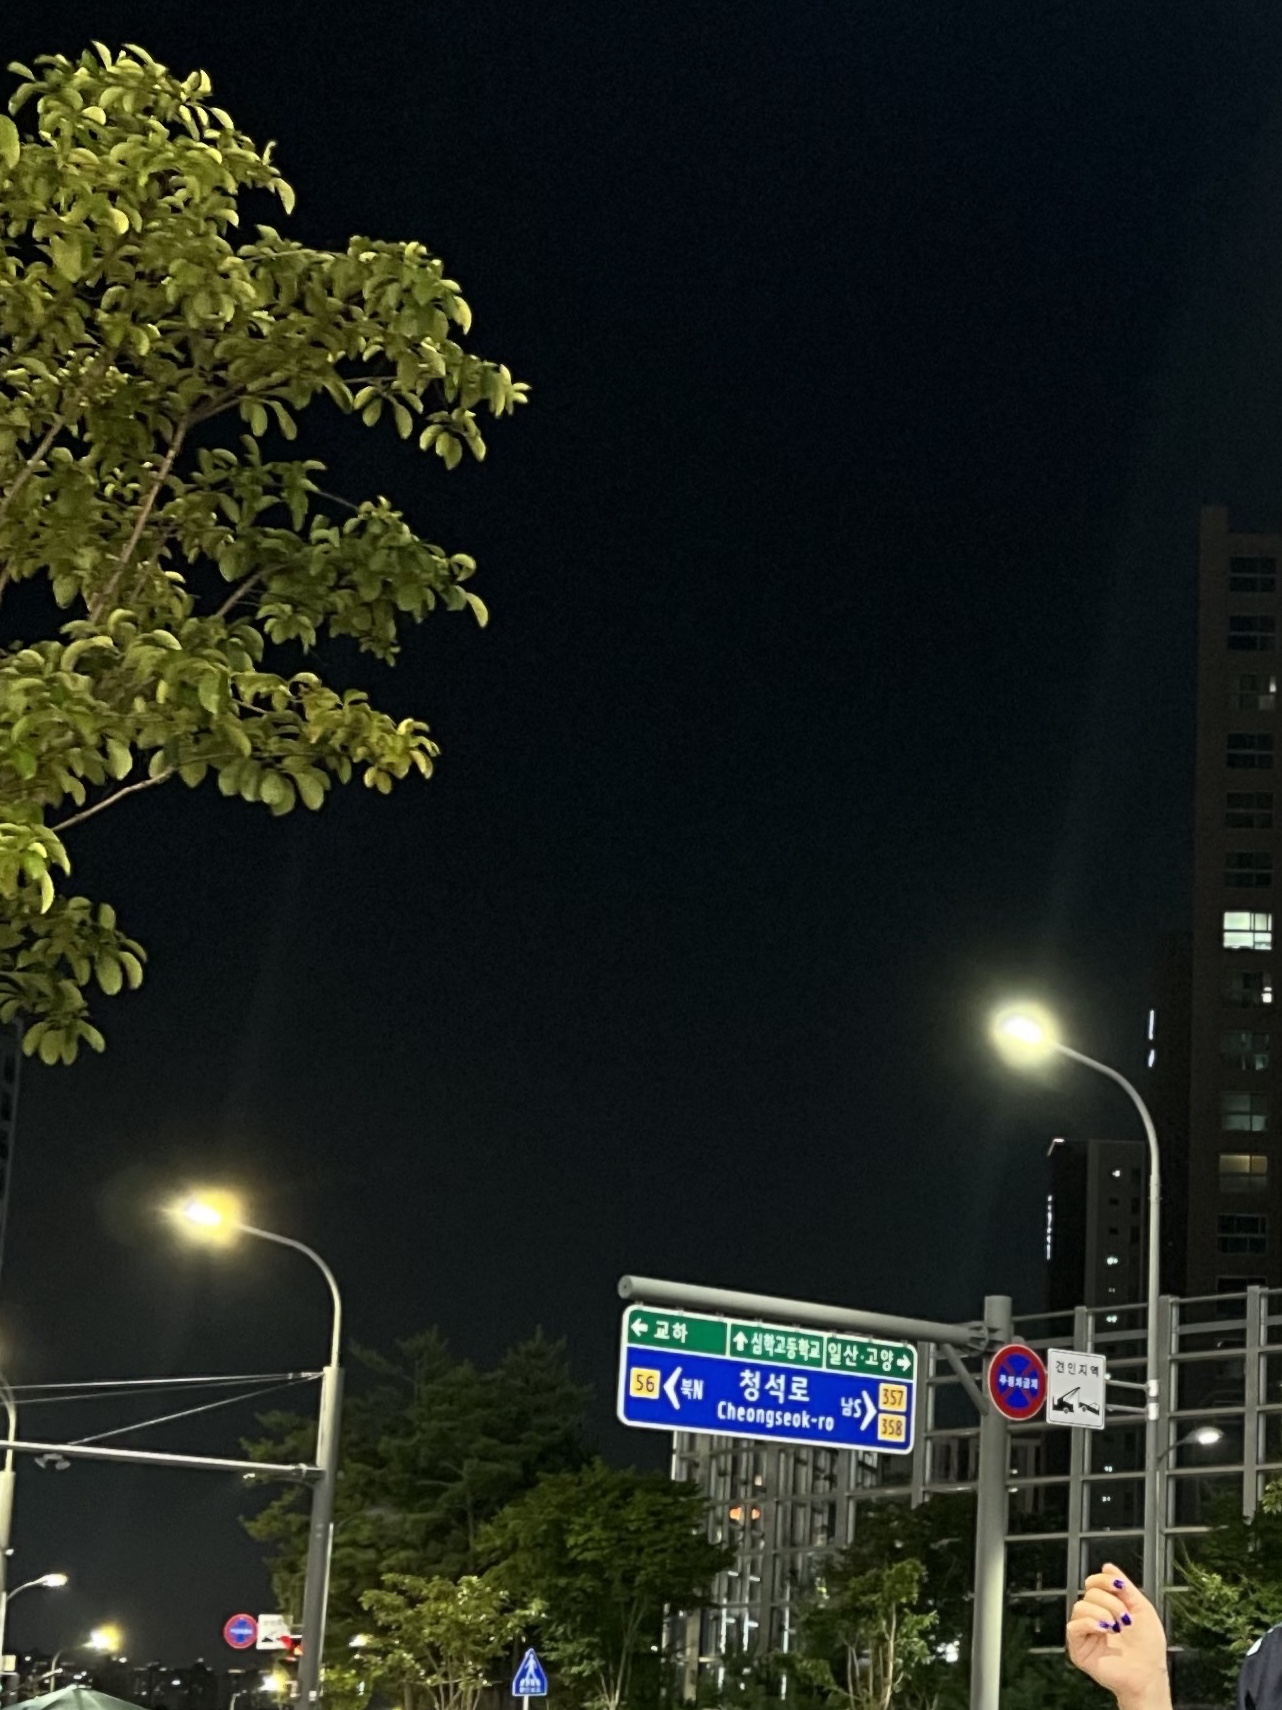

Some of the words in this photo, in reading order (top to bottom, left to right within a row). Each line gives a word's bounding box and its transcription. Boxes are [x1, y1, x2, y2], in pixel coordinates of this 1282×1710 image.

[653, 1320, 688, 1344] 교하
[750, 1332, 821, 1362] 심학고등학교
[1055, 1360, 1099, 1378] 견인지역
[635, 1374, 655, 1393] 56
[739, 1368, 810, 1405] 청석로
[882, 1388, 904, 1406] 357
[717, 1401, 835, 1432] Cheongseok-ro
[881, 1418, 902, 1436] 358
